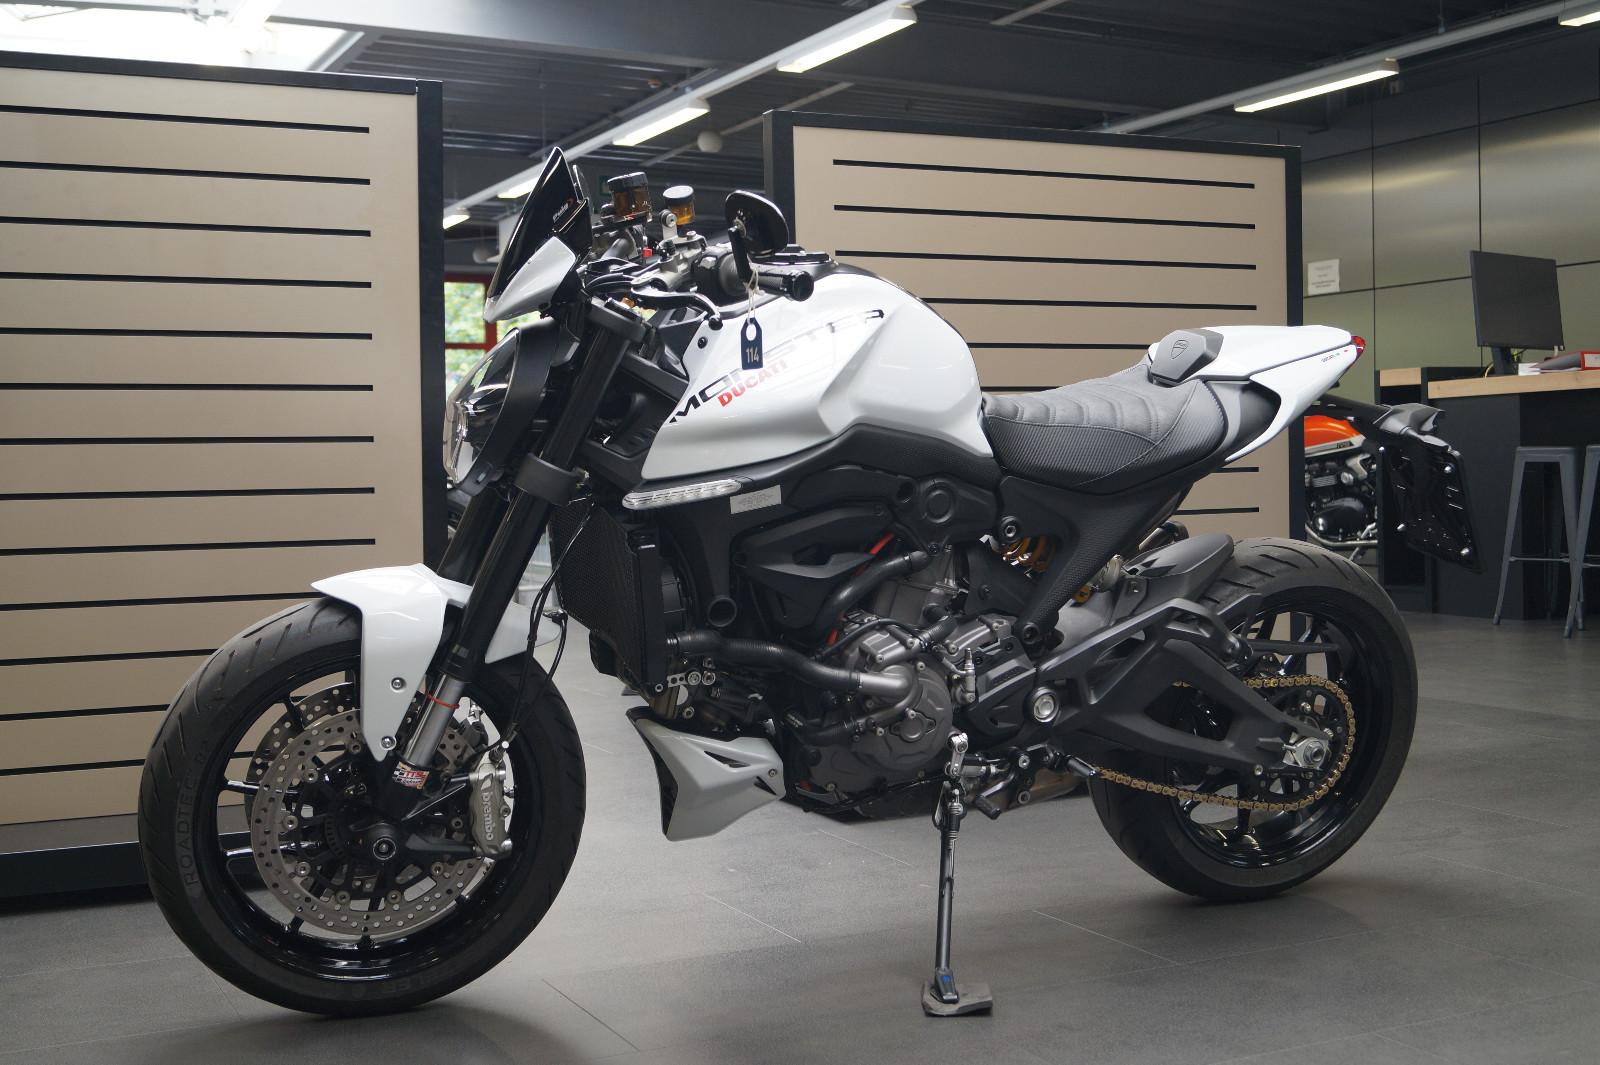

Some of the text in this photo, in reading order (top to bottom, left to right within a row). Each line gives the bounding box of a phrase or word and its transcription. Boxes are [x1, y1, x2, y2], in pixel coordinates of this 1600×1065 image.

[745, 346, 760, 364] 114
[718, 359, 787, 407] DUCATI
[481, 792, 494, 841] brembo
